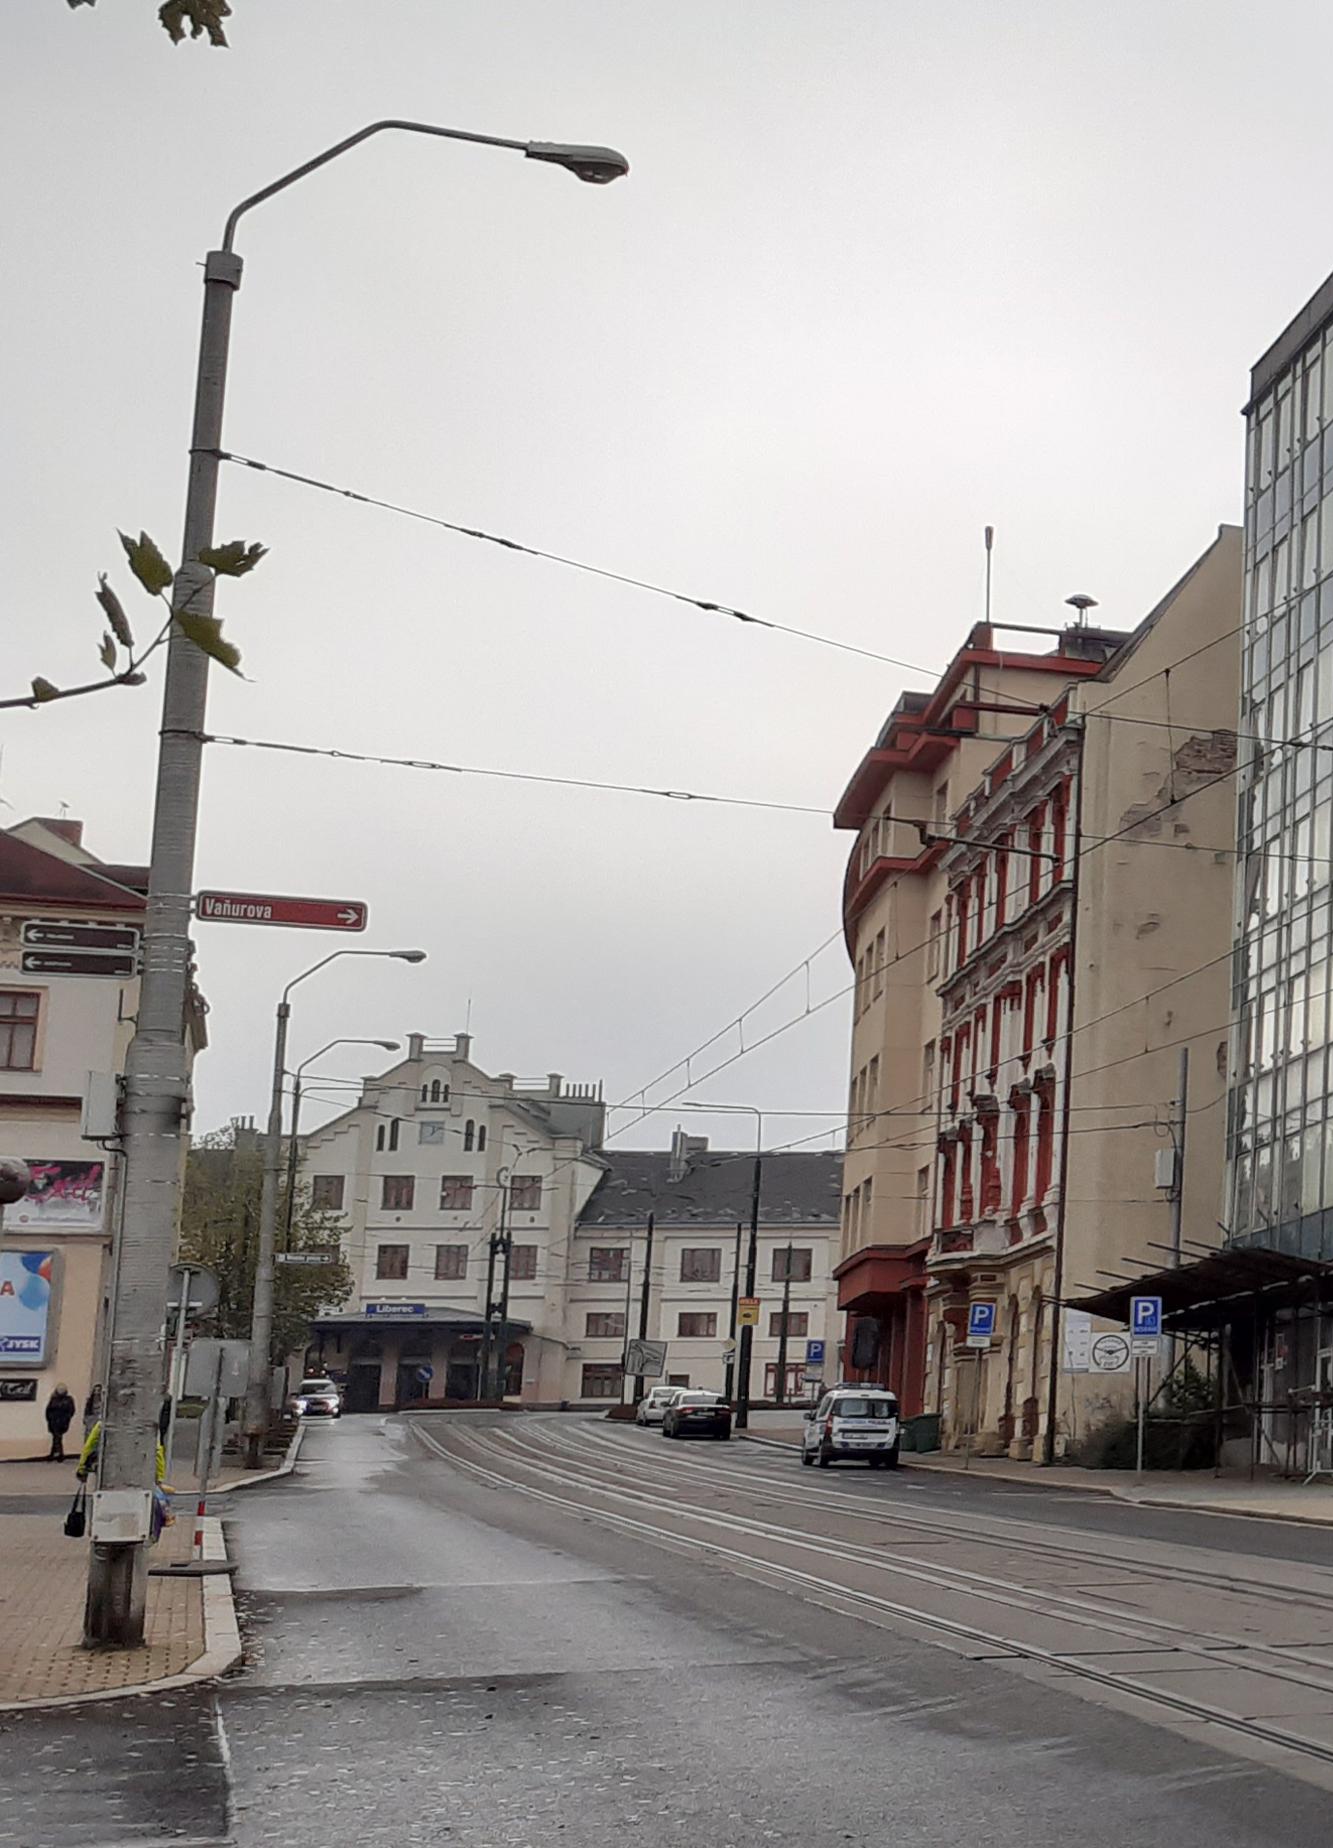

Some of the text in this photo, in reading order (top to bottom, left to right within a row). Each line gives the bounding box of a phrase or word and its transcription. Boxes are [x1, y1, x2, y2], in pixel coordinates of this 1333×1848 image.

[205, 897, 272, 919] Vaňurova
[377, 1305, 414, 1313] Liberec
[6, 1339, 39, 1349] JYSK
